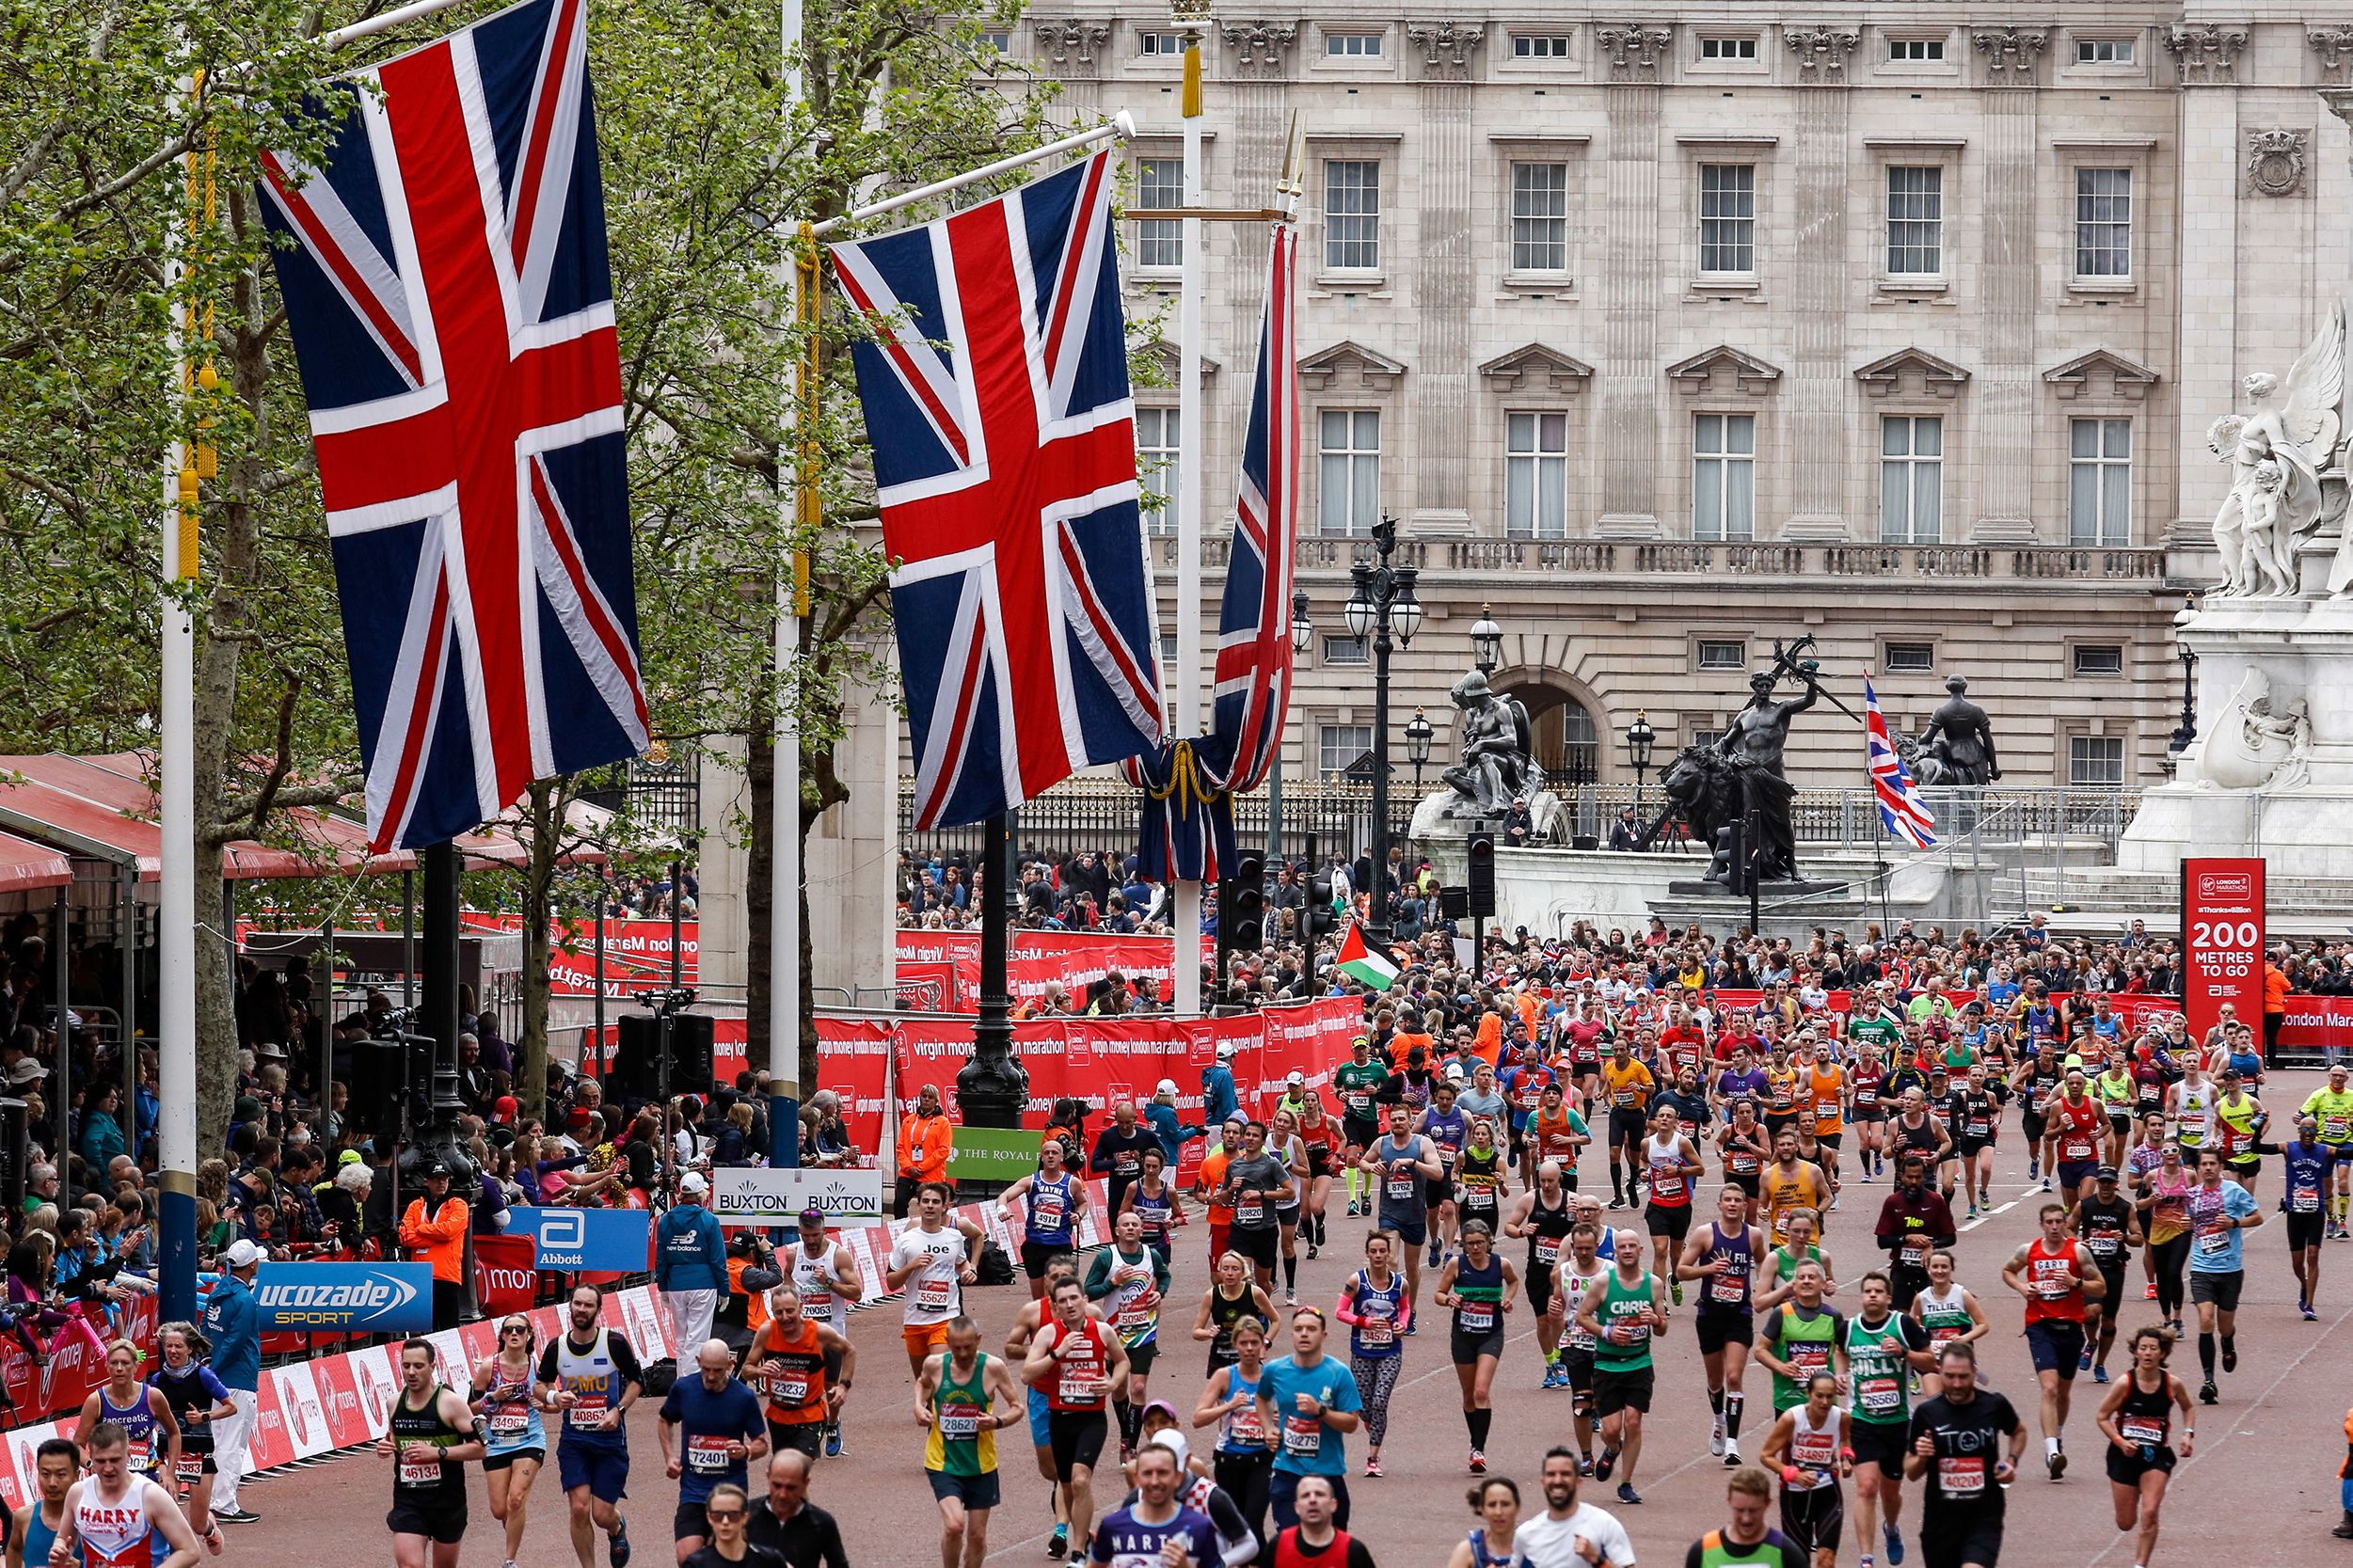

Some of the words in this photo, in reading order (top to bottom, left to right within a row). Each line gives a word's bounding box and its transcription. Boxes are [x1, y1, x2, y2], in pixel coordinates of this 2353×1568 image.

[2192, 922, 2257, 948] 200
[2195, 951, 2254, 963] METRES
[2200, 965, 2222, 976] TO
[2225, 965, 2249, 976] GO
[2282, 1012, 2324, 1026] ondon
[834, 1040, 854, 1058] money
[914, 1038, 946, 1061] virgin
[946, 1040, 976, 1055] mone
[1024, 1037, 1065, 1054] marathon
[1090, 1037, 1108, 1057] virgin
[1109, 1040, 1129, 1058] money
[1131, 1037, 1155, 1054] london
[1155, 1037, 1186, 1054] marathon
[1174, 1093, 1194, 1108] ondon
[963, 1148, 988, 1159] THE
[994, 1149, 1031, 1162] ROYAL
[2293, 1159, 2322, 1169] BOSTON
[1038, 1185, 1064, 1196] WAYNE
[1391, 1182, 1410, 1191] 8762
[720, 1195, 787, 1210] BUXTON
[808, 1196, 875, 1212] BUXTON
[1471, 1195, 1491, 1204] 33107
[1038, 1214, 1057, 1225] 4914
[2202, 1233, 2228, 1245] 72640
[676, 1243, 702, 1252] balance
[923, 1244, 950, 1254] Joe
[539, 1253, 582, 1265] Abbott
[2038, 1260, 2065, 1269] GARY
[920, 1291, 947, 1304] 55623
[803, 1306, 831, 1316] 70063
[1610, 1300, 1650, 1314] CHRIS
[1927, 1303, 1956, 1312] TILLIE
[274, 1312, 354, 1324] SPORT
[1122, 1313, 1148, 1325] 50982
[1363, 1330, 1391, 1341] 34522
[774, 1382, 806, 1396] 23232
[1866, 1393, 1899, 1406] 26560
[103, 1413, 149, 1426] Pancreatic
[494, 1417, 527, 1429] 34967
[944, 1418, 977, 1431] 28627
[1936, 1427, 1995, 1454] TOM
[692, 1451, 725, 1465] 72401
[405, 1465, 439, 1480] 46134
[80, 1507, 140, 1524] HARRY
[1111, 1534, 1195, 1552] MARTN
